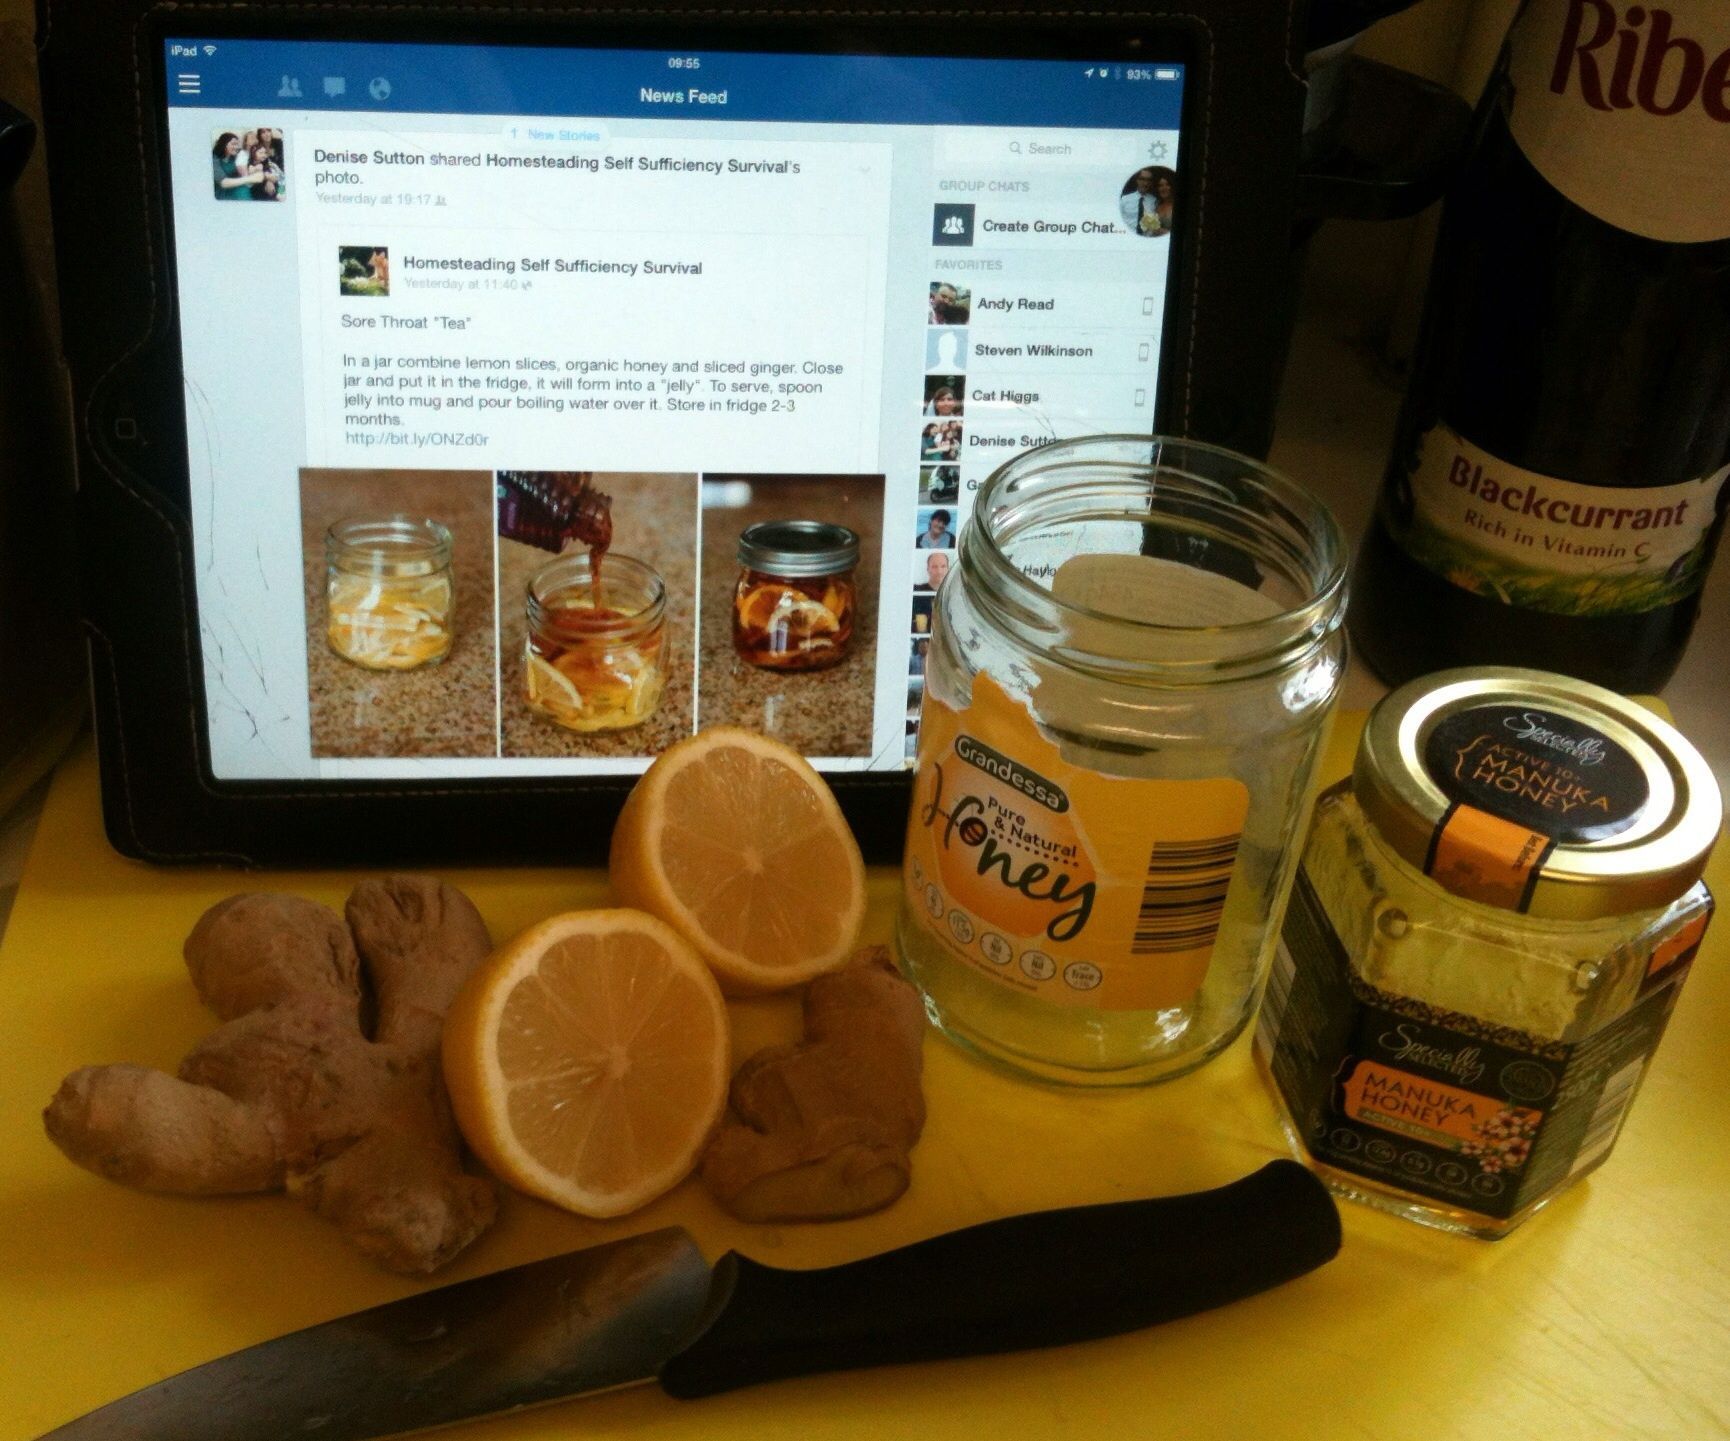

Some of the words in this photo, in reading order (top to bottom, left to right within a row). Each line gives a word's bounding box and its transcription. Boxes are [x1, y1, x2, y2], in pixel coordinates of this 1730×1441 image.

[171, 45, 197, 57] iPad
[668, 57, 700, 69] 09:55
[1126, 69, 1151, 80] 93%
[640, 88, 684, 103] News
[689, 89, 728, 105] Feed
[528, 129, 554, 140] New
[559, 130, 600, 142] Stories
[1028, 143, 1072, 155] Search
[314, 149, 368, 165] Denise
[373, 151, 425, 166] Sutton
[430, 152, 481, 166] shared
[487, 154, 599, 172] Homesteading
[604, 155, 634, 170] Self
[638, 156, 723, 175] Sufficiency
[728, 158, 801, 174] Survival's
[315, 169, 364, 187] photo.
[939, 180, 985, 192] GROUP
[988, 181, 1030, 192] CHATS
[316, 191, 377, 207] Yesterday
[380, 193, 393, 205] at
[396, 194, 432, 206] 19:17
[982, 219, 1029, 233] Create
[1033, 221, 1076, 236] Group
[404, 256, 516, 274] Homesteading
[520, 258, 550, 272] Self
[554, 258, 638, 276] Sufficiency
[643, 260, 703, 275] Survival
[935, 259, 1003, 271] FAVORITES
[405, 277, 465, 292] Yesterday
[468, 279, 480, 290] at
[483, 278, 519, 291] 11:40
[977, 297, 1014, 314] Andy
[1018, 298, 1055, 311] Read
[341, 314, 377, 329] Sore
[380, 314, 428, 330] Throat
[433, 316, 472, 331] "Tea"
[975, 344, 1022, 357] Steven
[1026, 344, 1093, 358] Wilkinson
[343, 354, 356, 368] In
[361, 357, 371, 368] a
[373, 354, 393, 371] jar
[397, 354, 461, 370] combine
[465, 355, 511, 370] lemon
[515, 356, 561, 373] slices,
[565, 359, 619, 375] organic
[623, 358, 669, 376] honey
[672, 359, 699, 373] and
[703, 361, 745, 375] sliced
[750, 361, 797, 378] ginger.
[802, 361, 844, 375] Close
[343, 373, 362, 390] jar
[366, 374, 394, 388] and
[398, 375, 423, 393] put
[427, 374, 437, 388] it
[440, 375, 454, 389] in
[458, 375, 481, 390] the
[485, 375, 532, 393] fridge,
[536, 377, 546, 391] it
[550, 377, 573, 391] will
[577, 377, 611, 392] form
[615, 378, 642, 392] into
[646, 382, 656, 392] a
[709, 380, 726, 393] To
[731, 381, 773, 395] serve,
[778, 381, 823, 397] spoon
[344, 393, 373, 410] jelly
[376, 393, 405, 408] into
[409, 396, 442, 412] mug
[446, 394, 474, 408] and
[478, 397, 512, 413] pour
[516, 395, 565, 413] boiling
[568, 397, 609, 411] water
[613, 397, 645, 411] over
[649, 396, 662, 411] it.
[667, 398, 705, 413] Store
[709, 398, 722, 412] in
[725, 399, 768, 416] fridge
[771, 399, 796, 413] 2-3
[972, 389, 997, 402] Cat
[1000, 390, 1040, 405] Higgs
[345, 411, 405, 427] months.
[969, 434, 1016, 447] Denise
[1449, 454, 1689, 531] Blackcurrant
[1463, 507, 1507, 539] Rich
[1514, 527, 1534, 547] in
[1543, 534, 1627, 558] Vitamin
[1634, 541, 1651, 560] C
[1488, 744, 1551, 770] ACTIVE
[957, 735, 1061, 810] Grandessa
[1473, 766, 1578, 813] HONEY
[1480, 753, 1608, 812] MANUKA
[987, 795, 1026, 827] Pure
[994, 815, 1006, 831] &
[1011, 826, 1077, 859] Natural
[922, 762, 1097, 942] Honey
[1378, 1023, 1486, 1085] Specially
[1363, 1071, 1478, 1119] MANUKA
[1359, 1087, 1451, 1127] HONEY
